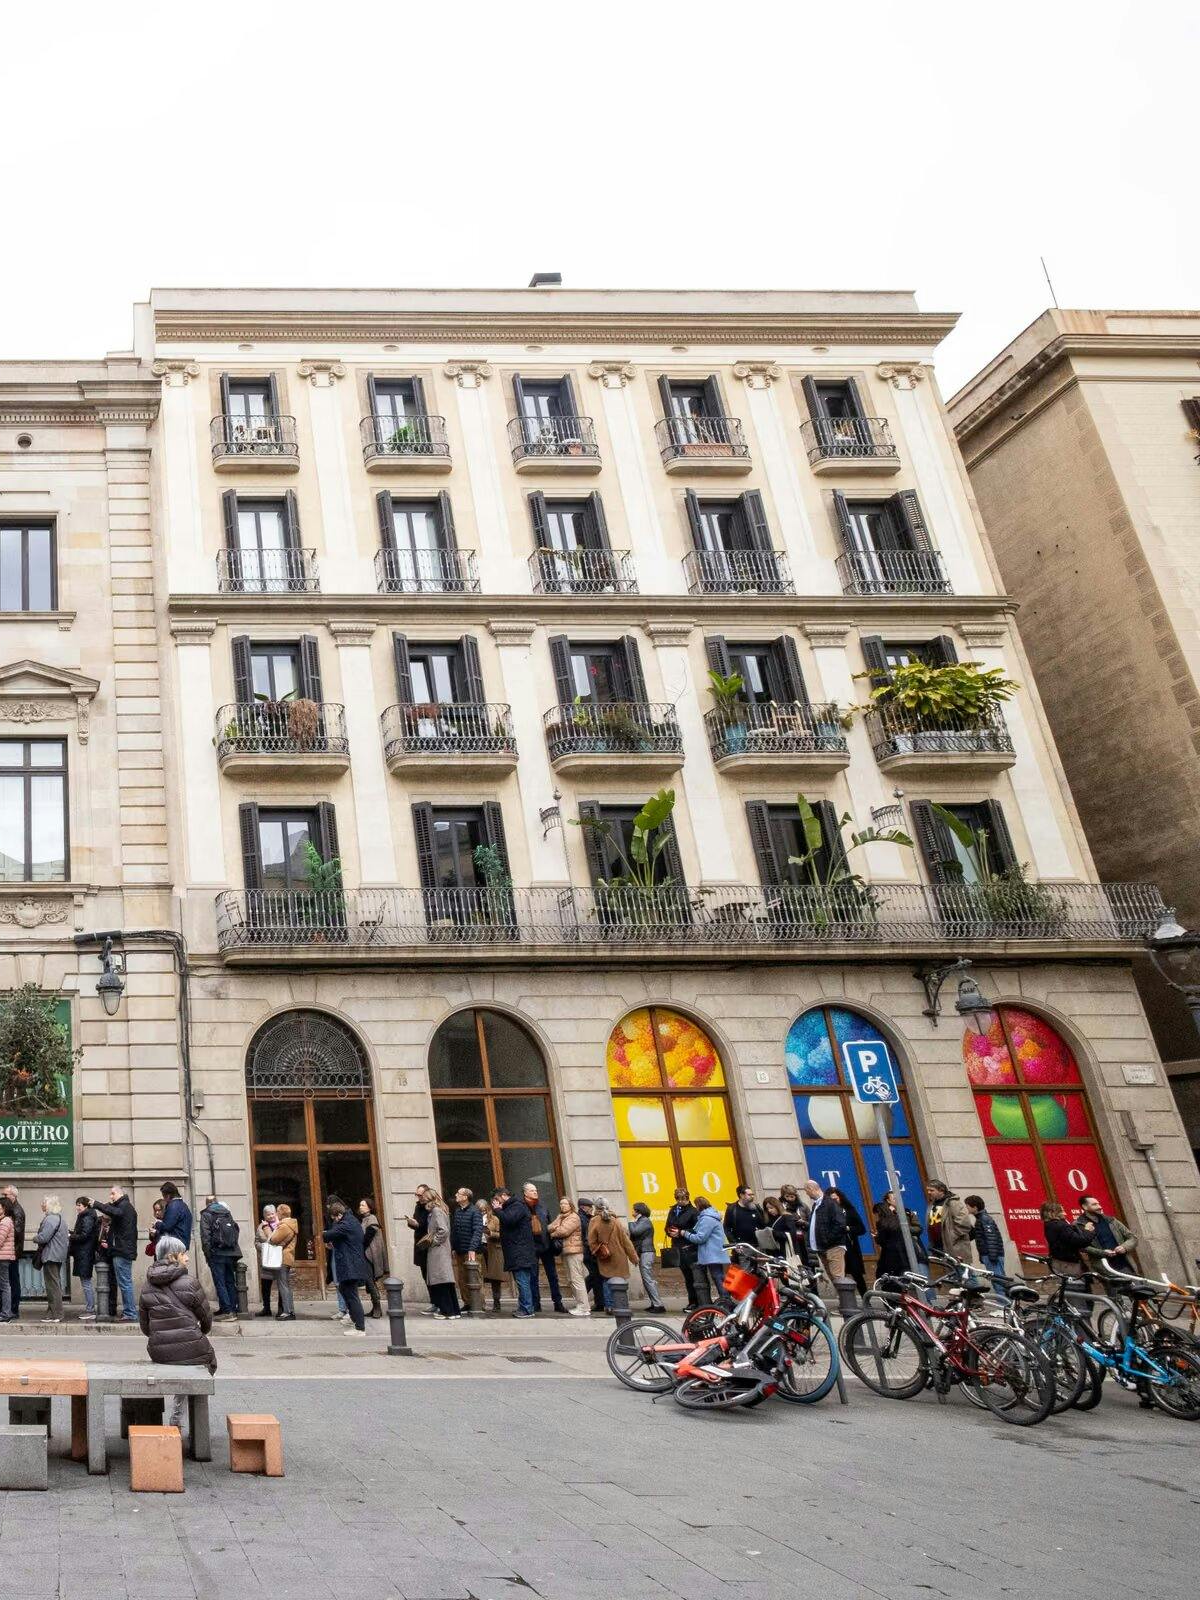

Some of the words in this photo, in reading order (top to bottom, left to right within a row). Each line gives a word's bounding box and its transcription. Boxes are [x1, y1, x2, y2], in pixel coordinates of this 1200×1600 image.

[858, 1051, 878, 1073] P
[640, 1172, 660, 1194] B
[702, 1171, 721, 1193] O
[821, 1170, 841, 1188] T
[884, 1170, 906, 1192] E
[1004, 1168, 1029, 1192] R
[1068, 1168, 1088, 1192] O
